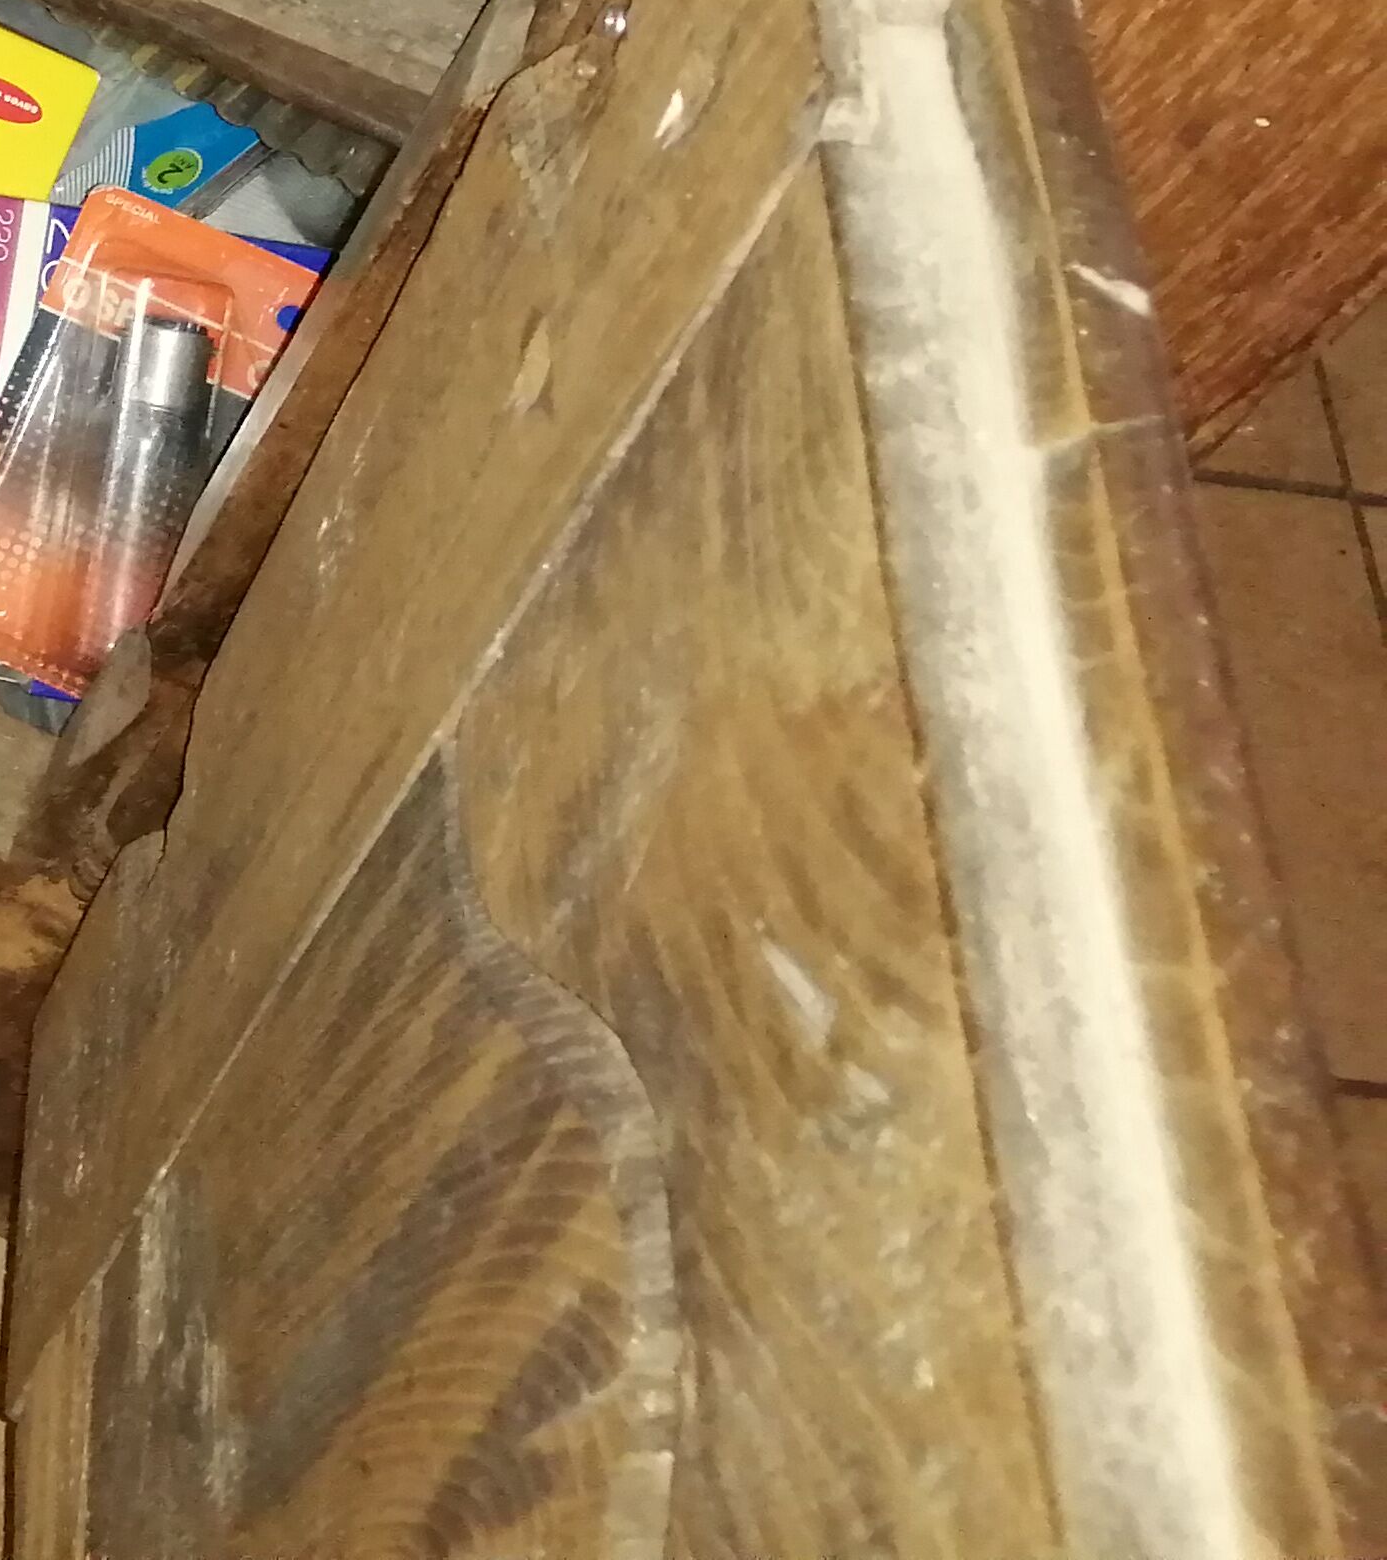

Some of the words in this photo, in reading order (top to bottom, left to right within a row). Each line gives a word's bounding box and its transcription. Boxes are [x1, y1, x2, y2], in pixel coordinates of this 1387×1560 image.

[2, 93, 39, 115] saves
[157, 162, 184, 185] 2
[105, 192, 161, 225] SPECIAL
